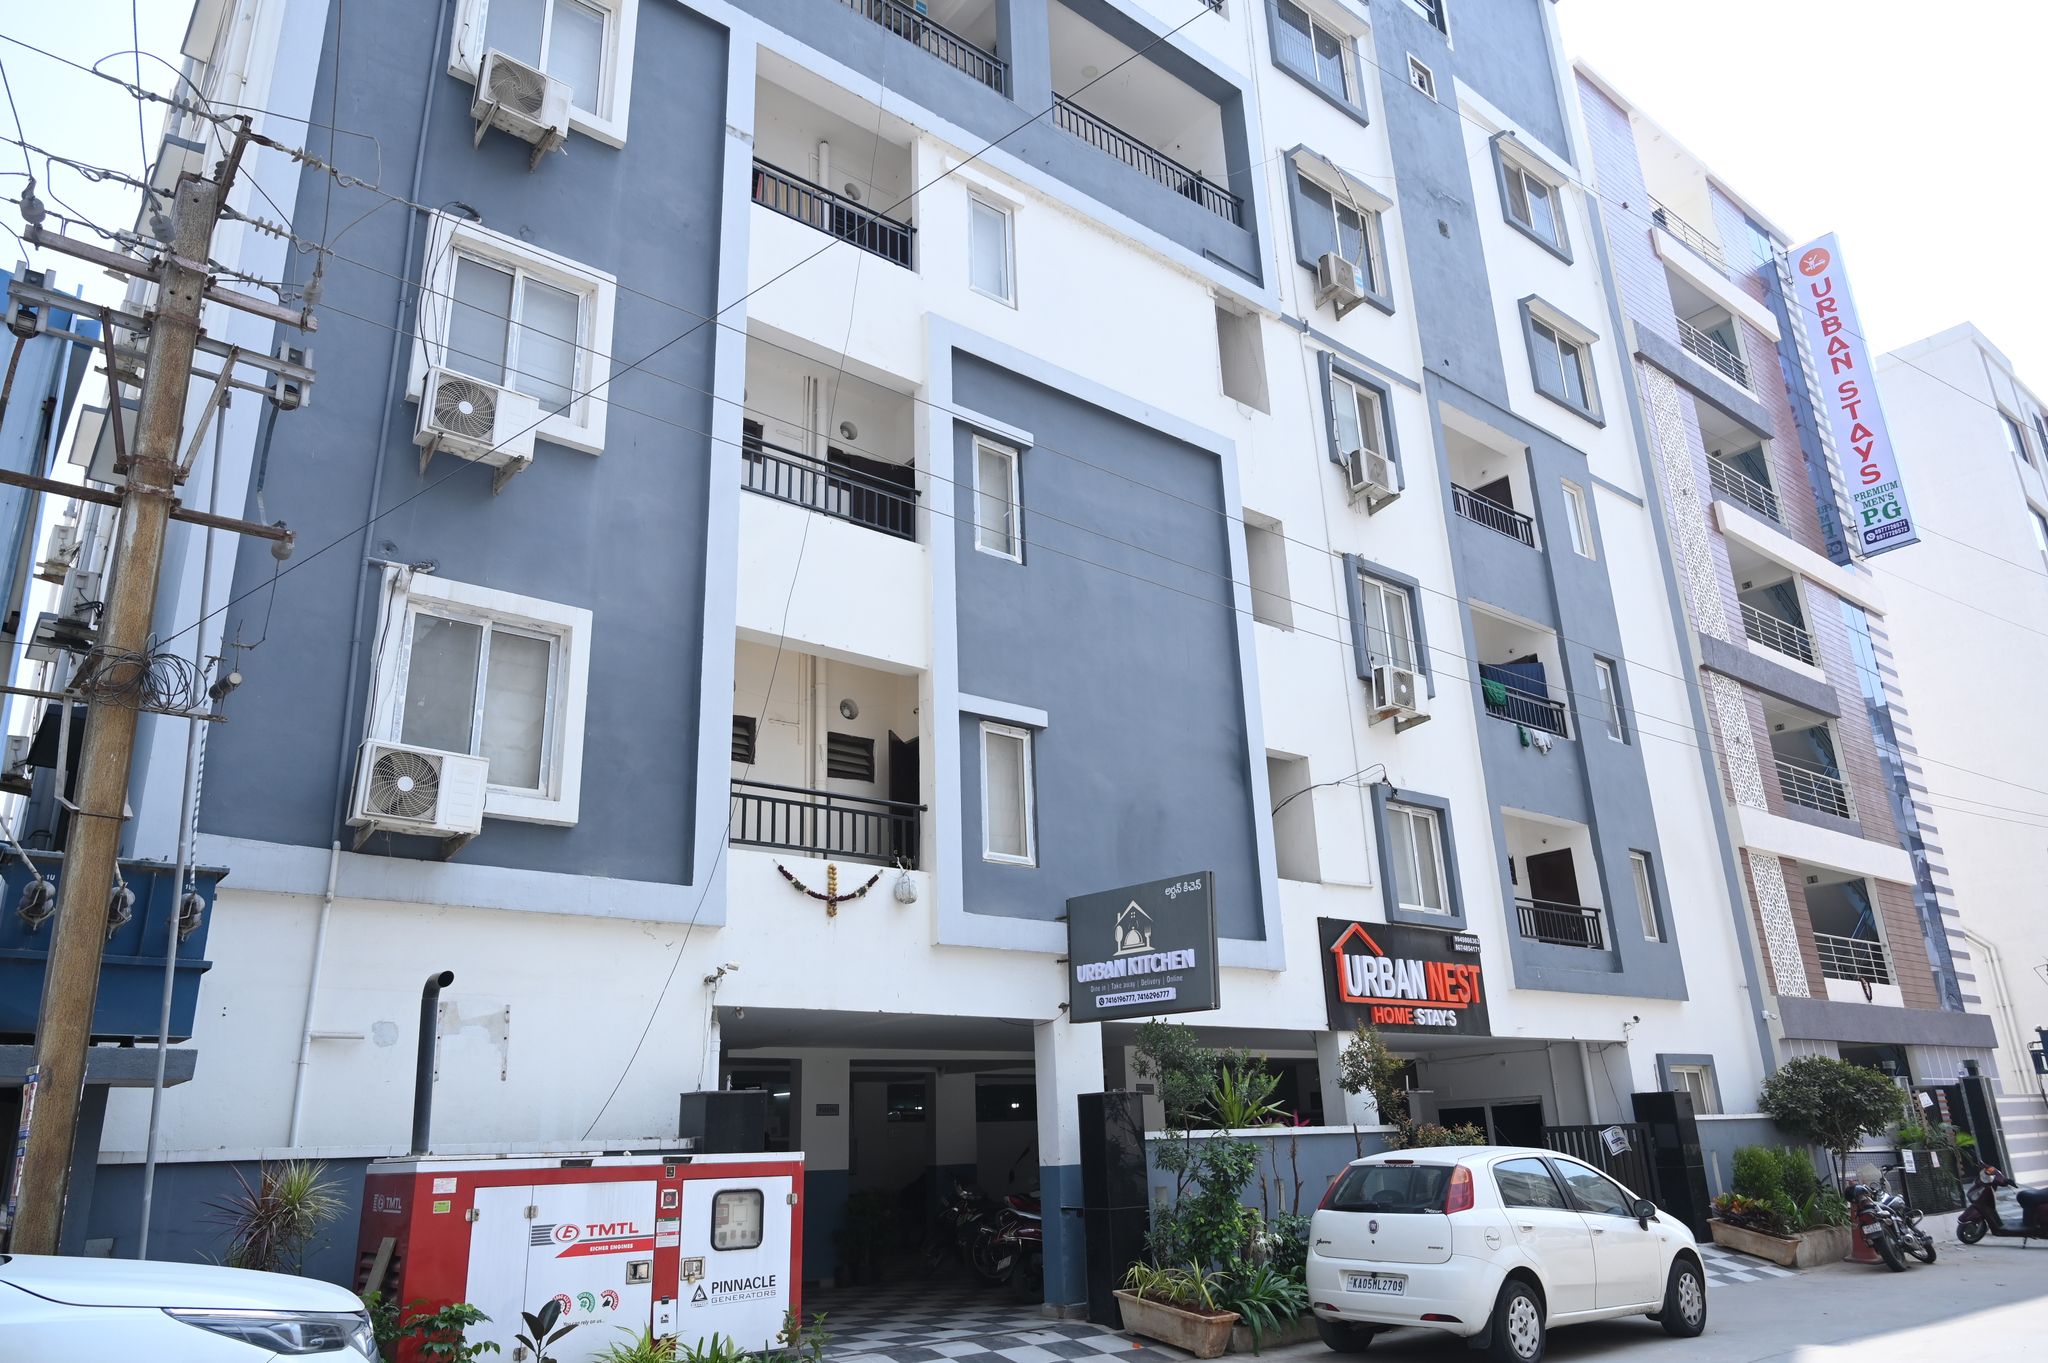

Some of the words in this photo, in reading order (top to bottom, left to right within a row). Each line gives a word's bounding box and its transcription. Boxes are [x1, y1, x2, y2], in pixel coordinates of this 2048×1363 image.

[1810, 276, 1853, 375] URBAN
[1838, 380, 1882, 486] STAYS
[1853, 480, 1899, 501] PREMIUM
[1862, 492, 1895, 509] MEN'S
[1860, 500, 1902, 528] P.G
[1076, 958, 1127, 983] URBAN
[1128, 949, 1196, 976] KITCHEN
[1090, 985, 1100, 993] Dine
[1111, 982, 1122, 990] Take
[1123, 981, 1135, 989] away
[1141, 978, 1161, 987] Delivery
[1167, 974, 1183, 983] Online
[1344, 953, 1427, 1000] URBAN
[1425, 961, 1480, 1004] NEST
[1371, 1005, 1414, 1025] HOME
[1413, 1008, 1457, 1026] STAYS
[386, 1197, 402, 1209] TMTL
[586, 1222, 639, 1237] TMTL
[711, 1275, 776, 1294] PINNACLE
[711, 1289, 777, 1303] GENERATORS
